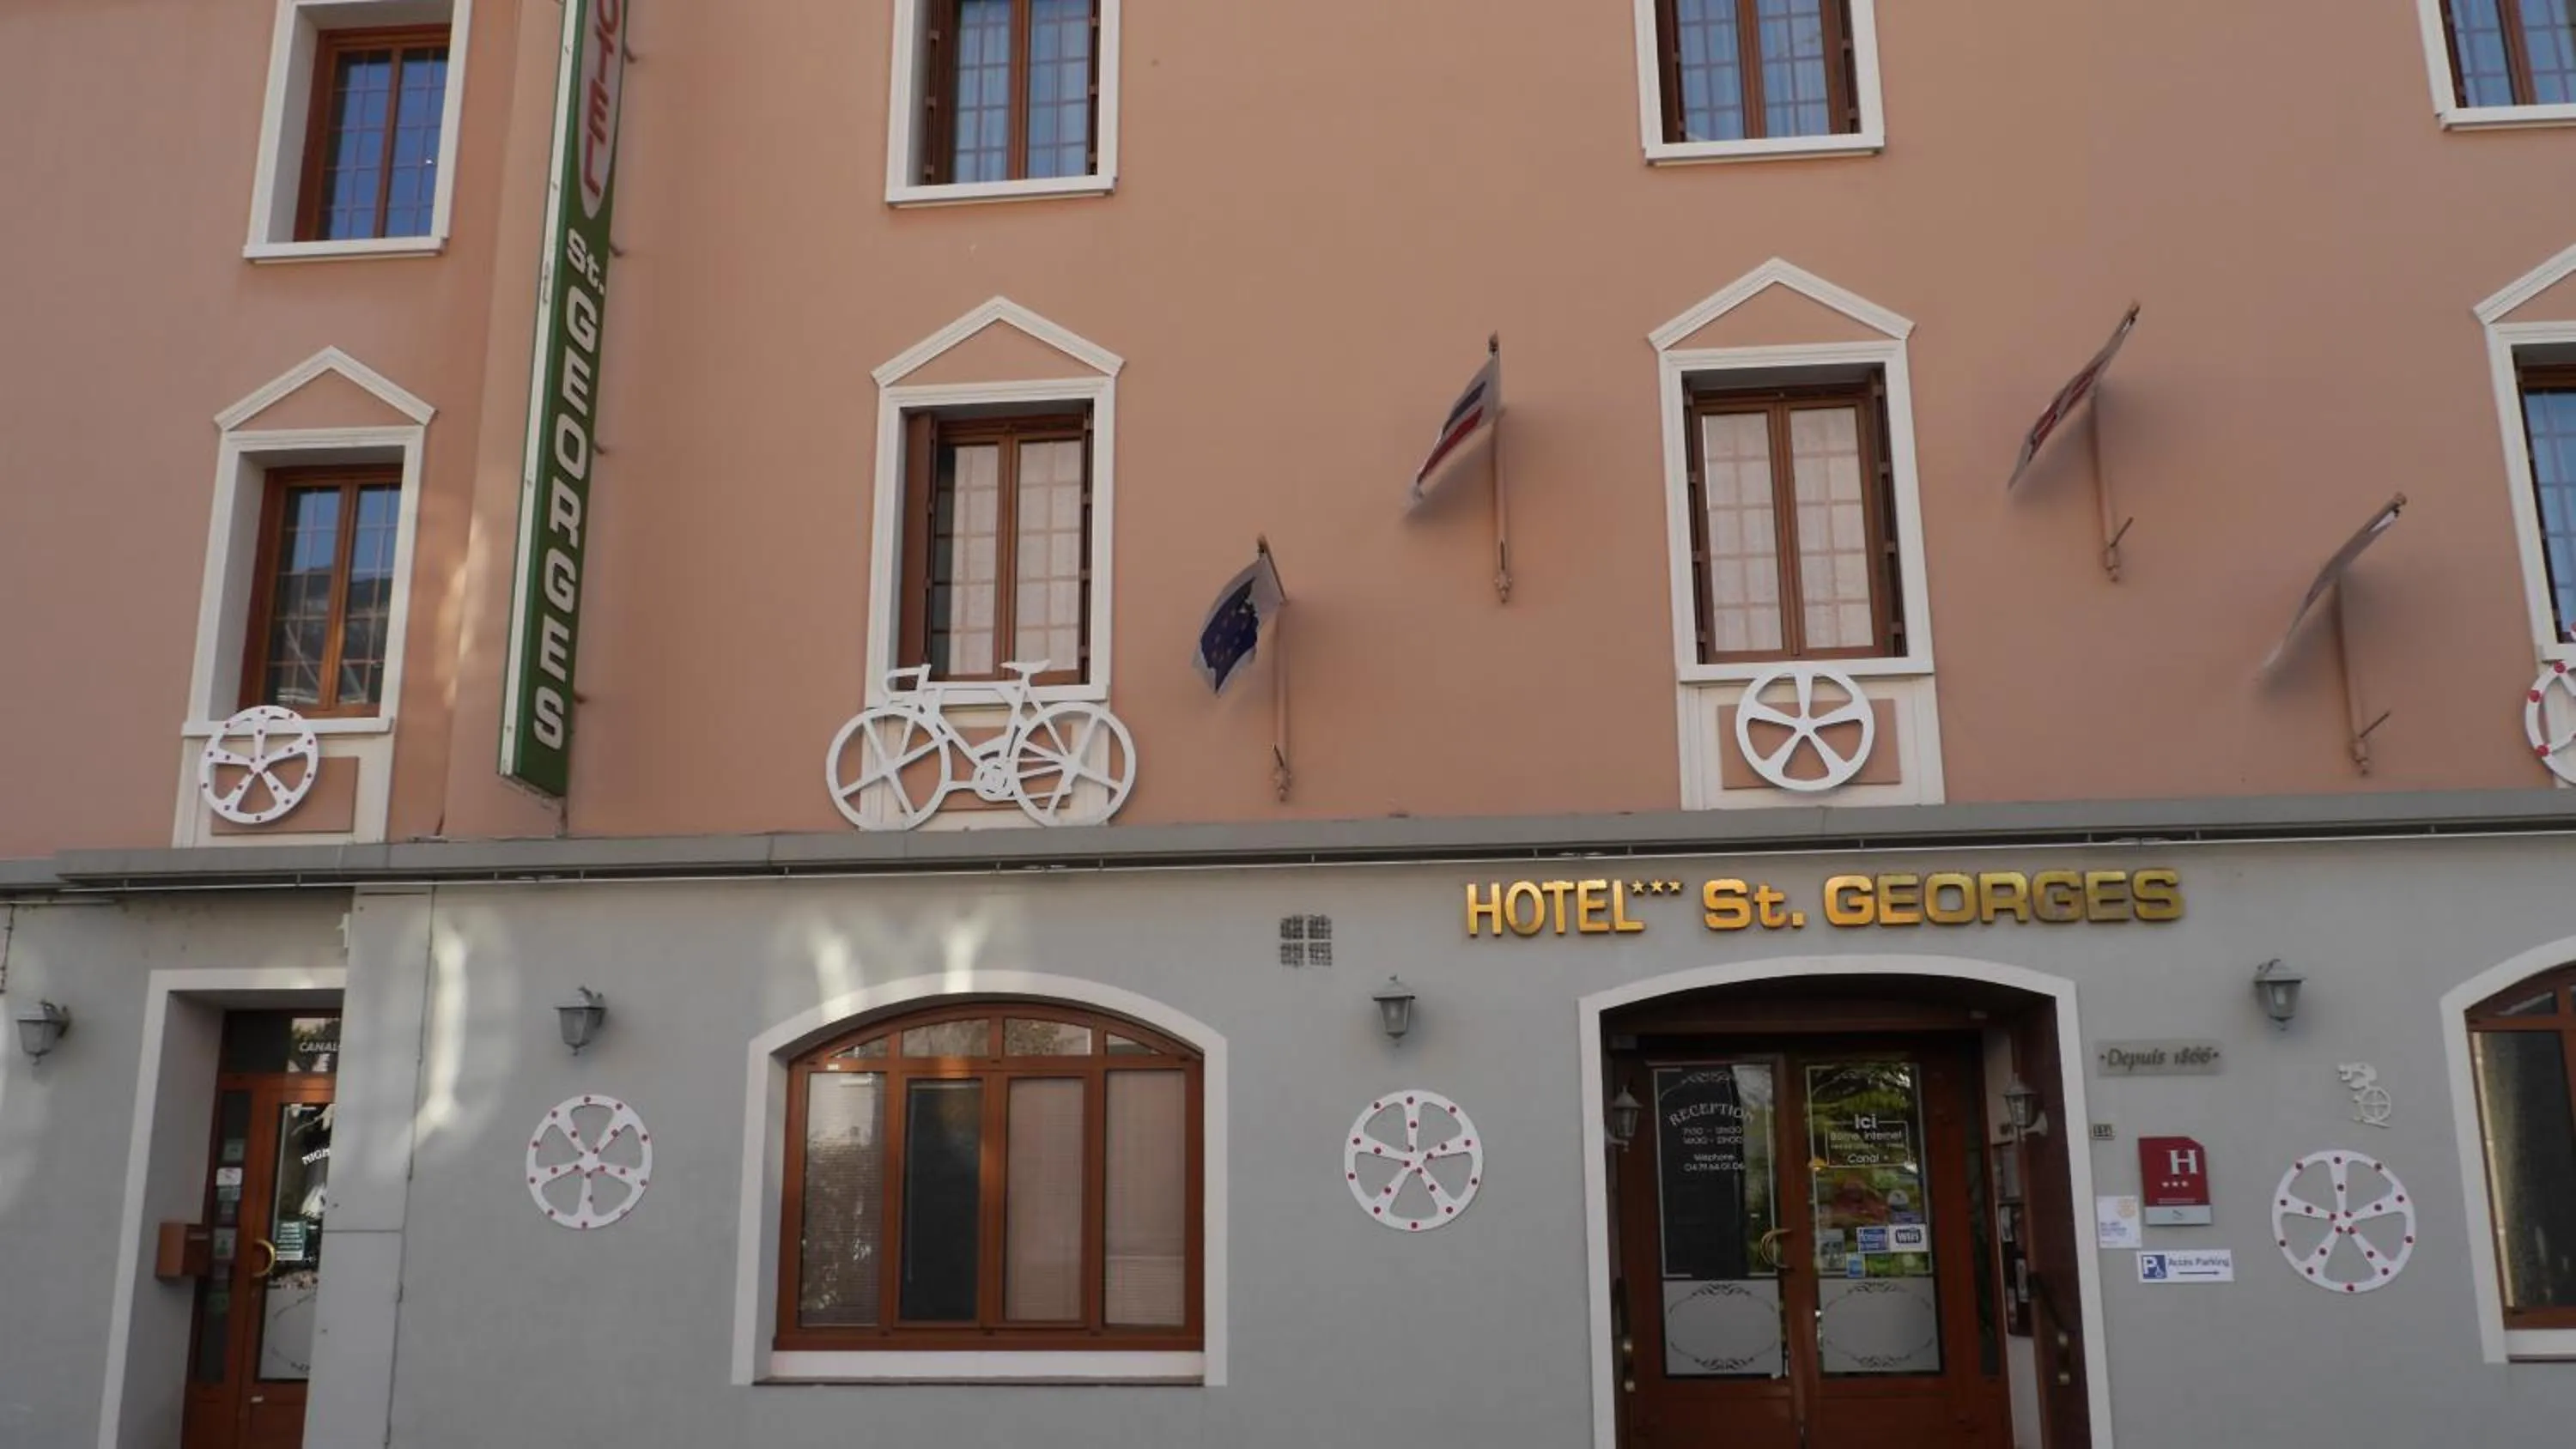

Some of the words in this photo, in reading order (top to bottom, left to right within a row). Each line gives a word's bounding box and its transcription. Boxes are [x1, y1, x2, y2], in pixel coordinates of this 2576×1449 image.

[567, 227, 605, 294] St.
[533, 286, 598, 750] GEORGES
[1466, 879, 1644, 937] HOTEL
[1702, 878, 1804, 930] St.
[1823, 869, 2184, 927] GEORGES
[2107, 1047, 2166, 1071] Depuis
[1668, 1102, 1754, 1125] RECEPTION
[1854, 1113, 1878, 1130] Ici
[1847, 1153, 1880, 1164] Canal
[2168, 1149, 2199, 1175] H
